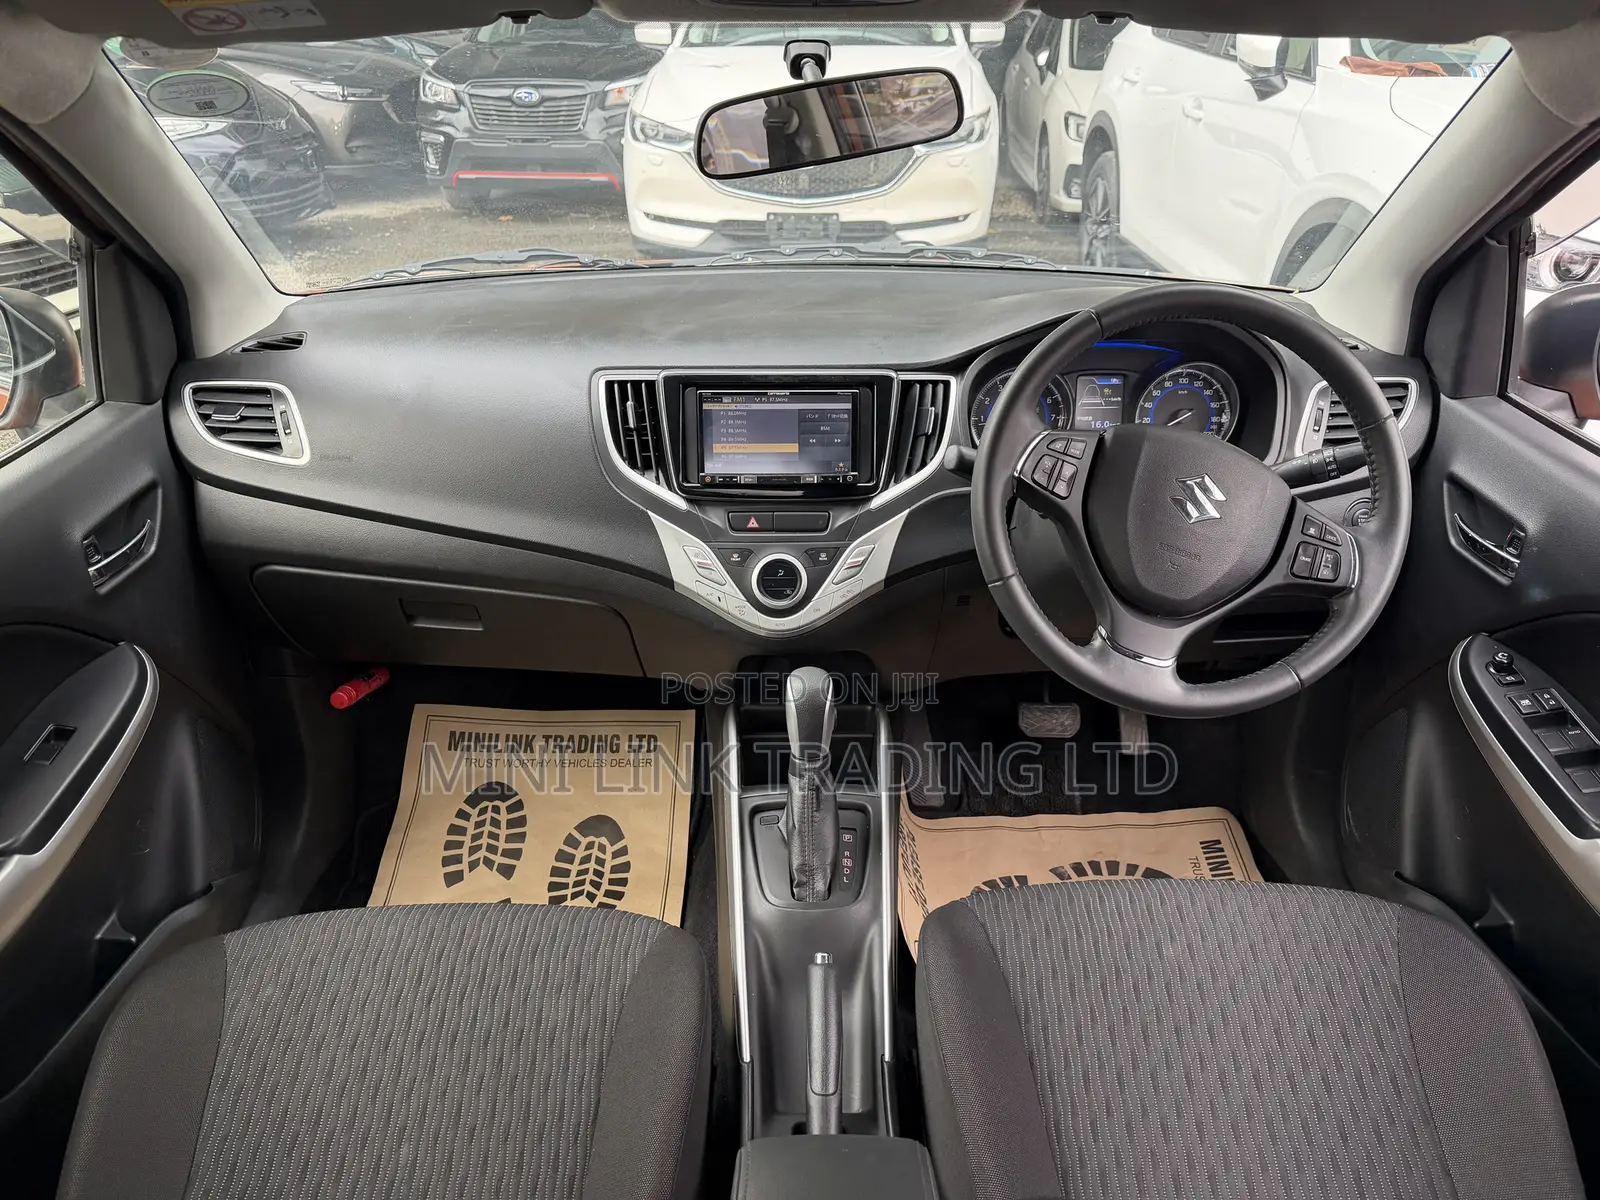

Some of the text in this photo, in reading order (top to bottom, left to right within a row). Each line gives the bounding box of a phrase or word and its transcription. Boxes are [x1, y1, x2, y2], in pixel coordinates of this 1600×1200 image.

[984, 397, 990, 405] 2
[1090, 420, 1110, 428] 16.0
[447, 730, 659, 755] MINILINK TRADING LTD
[464, 757, 653, 769] TRUST WORTHY VEHICLES DEALER
[1199, 839, 1235, 880] MINI
